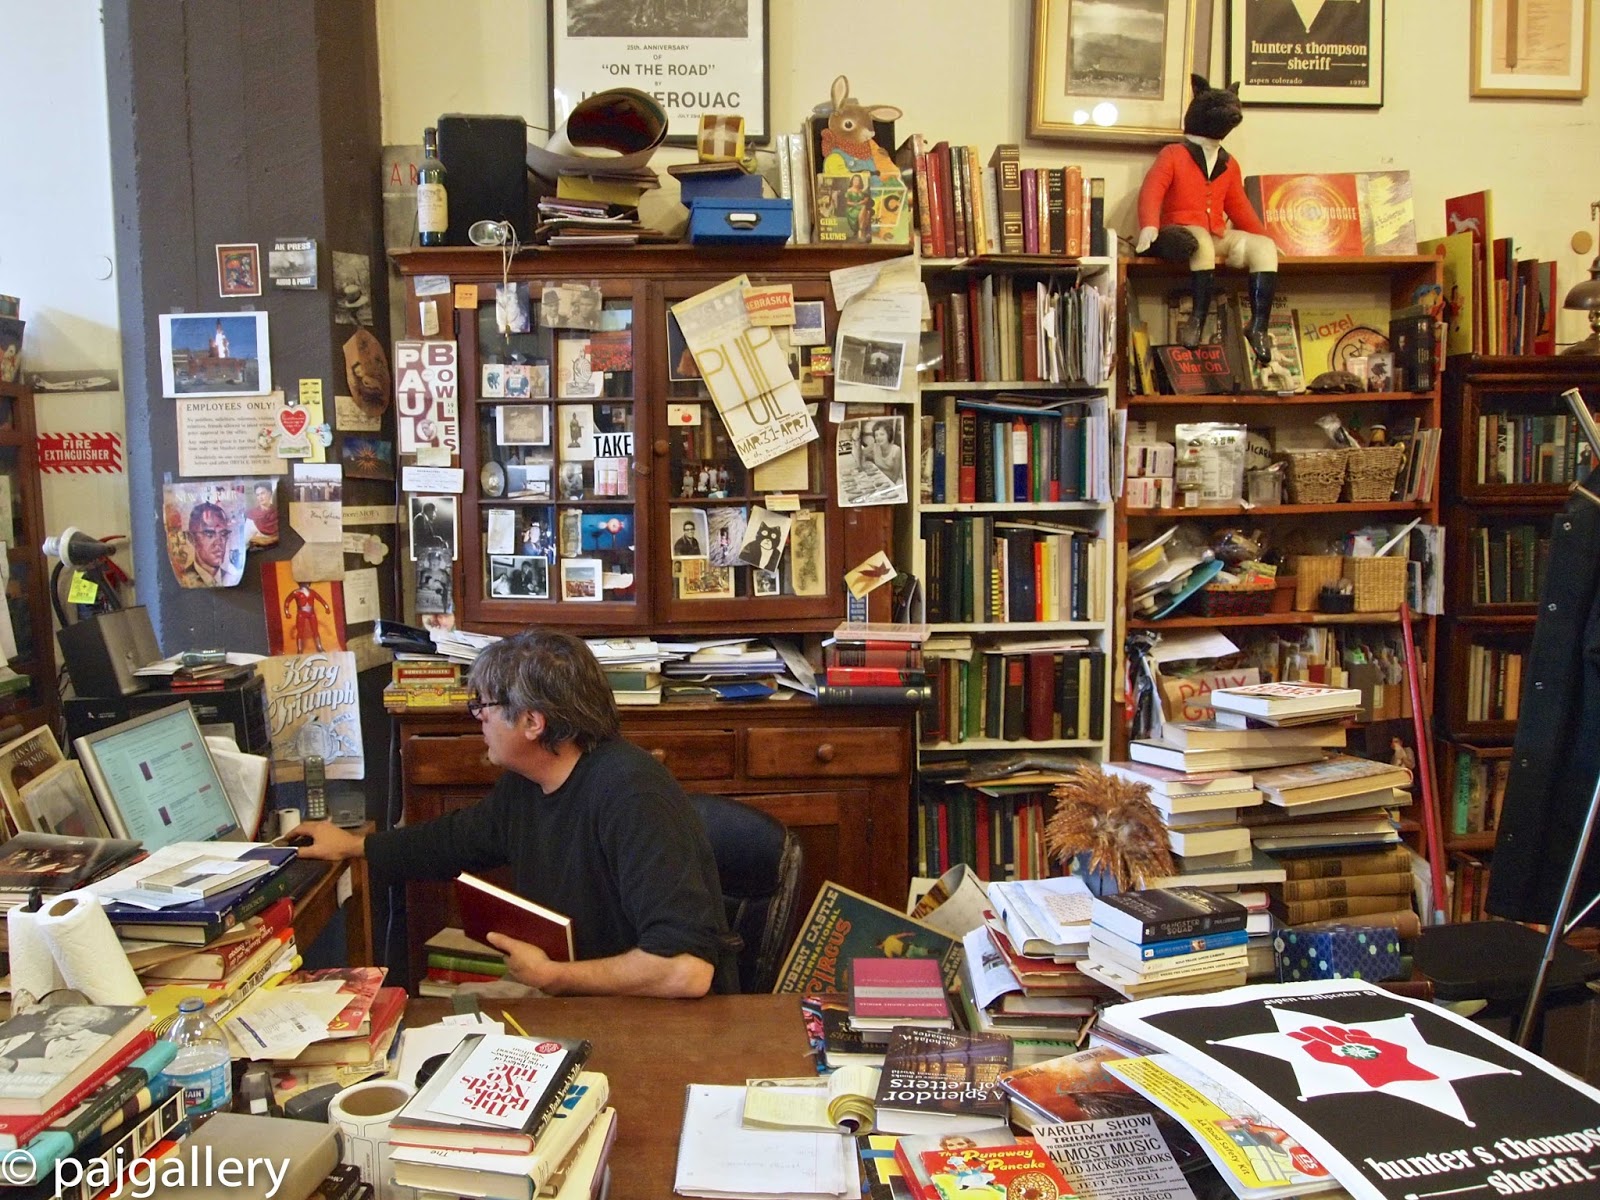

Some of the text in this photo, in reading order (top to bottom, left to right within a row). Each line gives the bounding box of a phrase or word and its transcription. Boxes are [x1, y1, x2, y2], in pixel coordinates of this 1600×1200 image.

[1251, 40, 1367, 56] hunter s. thompson
[635, 64, 663, 76] THE
[1287, 55, 1331, 70] sheriff
[652, 91, 740, 108] EROUAC
[287, 242, 311, 250] PRESS
[1303, 313, 1355, 342] Hazel
[1171, 349, 1193, 361] Get
[1178, 361, 1222, 373] War On
[186, 401, 276, 412] EMPLOYEES ONLY!
[62, 439, 91, 449] FIRE
[593, 434, 632, 457] TAKE
[44, 449, 109, 460] EXTINGUISHER
[272, 654, 340, 692] King
[268, 680, 355, 736] Triumph
[807, 889, 839, 944] CASTLE
[1161, 919, 1200, 930] GANGSTER
[1167, 926, 1193, 935] SQUAD
[796, 908, 842, 993] INTERNATIONAL
[806, 917, 852, 997] CIRCUS
[214, 1003, 232, 1019] Through
[915, 1036, 958, 1047] Nicholas
[496, 1064, 538, 1083] Title
[460, 1076, 530, 1098] Needs
[890, 1079, 994, 1091] of Letters
[475, 1086, 530, 1111] Book
[883, 1088, 1004, 1104] A Splendor
[462, 1096, 508, 1118] This
[1035, 1116, 1151, 1137] VARIETY SHOW
[1054, 1141, 1082, 1149] CELEBRATE
[1113, 1134, 1143, 1142] RELOCATION
[961, 1149, 1033, 1162] Runaway
[1049, 1137, 1161, 1164] ALMOST MUSIC
[1205, 1127, 1221, 1141] Road
[1220, 1138, 1238, 1162] Safety
[1238, 1160, 1250, 1175] Kit
[1364, 1126, 1600, 1180] hunter s. thomps
[986, 1159, 1045, 1172] Pancake
[1086, 1157, 1134, 1172] JACKSON
[1137, 1152, 1172, 1166] BOOKS
[1076, 1178, 1109, 1189] JEFF
[1487, 1157, 1596, 1195] sheriff
